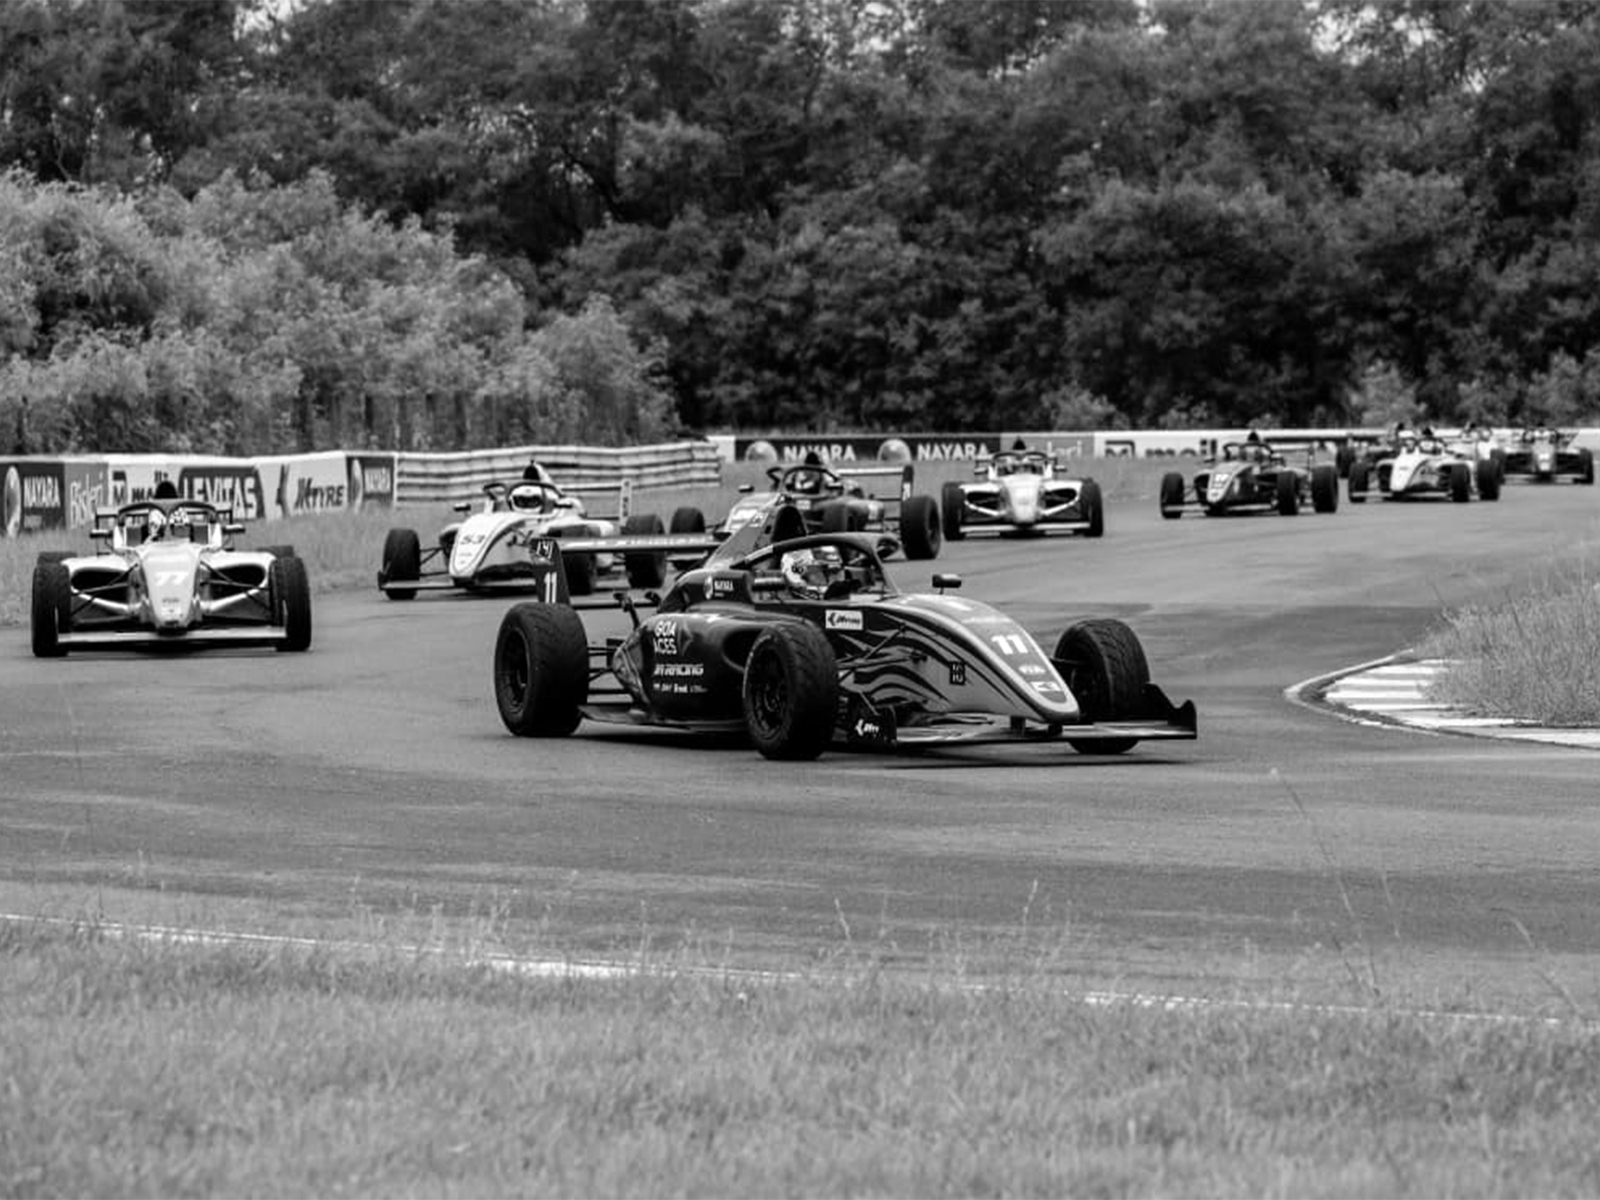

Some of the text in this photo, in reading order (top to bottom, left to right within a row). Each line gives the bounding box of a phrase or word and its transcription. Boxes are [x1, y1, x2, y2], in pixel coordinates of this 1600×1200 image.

[917, 443, 990, 460] NAYARA
[23, 476, 61, 508] NAYARA
[183, 476, 257, 519] LEVITAS
[155, 572, 189, 586] 77
[544, 572, 557, 604] 11
[654, 621, 677, 637] GOA
[991, 634, 1028, 656] 11
